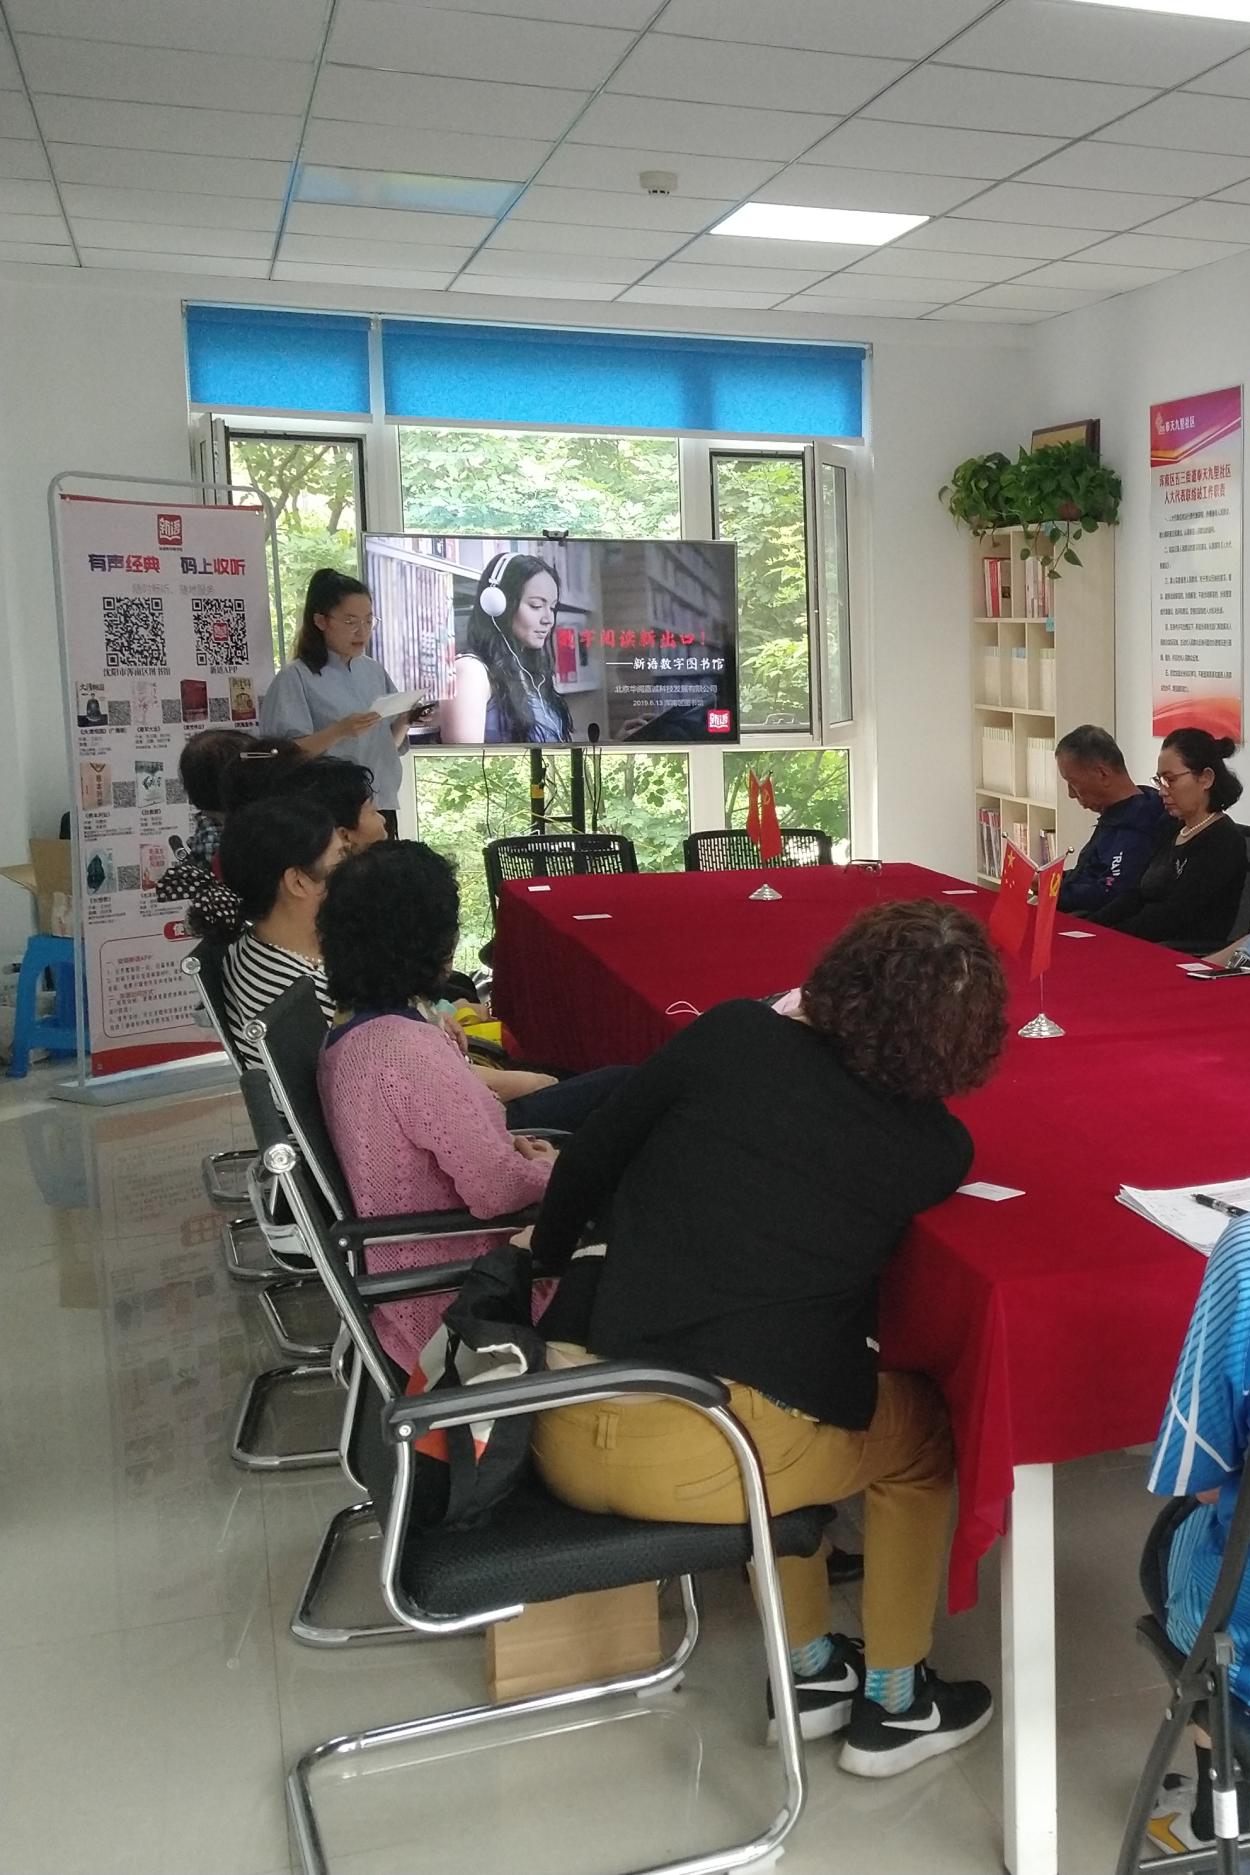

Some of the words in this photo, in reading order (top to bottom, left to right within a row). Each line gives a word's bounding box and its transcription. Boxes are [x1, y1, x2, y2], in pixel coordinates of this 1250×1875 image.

[1166, 416, 1195, 432] 奉天九里社区
[1160, 464, 1231, 487] 浑南区五三街道奉天九里社区
[88, 554, 160, 573] 有声经典
[180, 557, 245, 575] 码上收听
